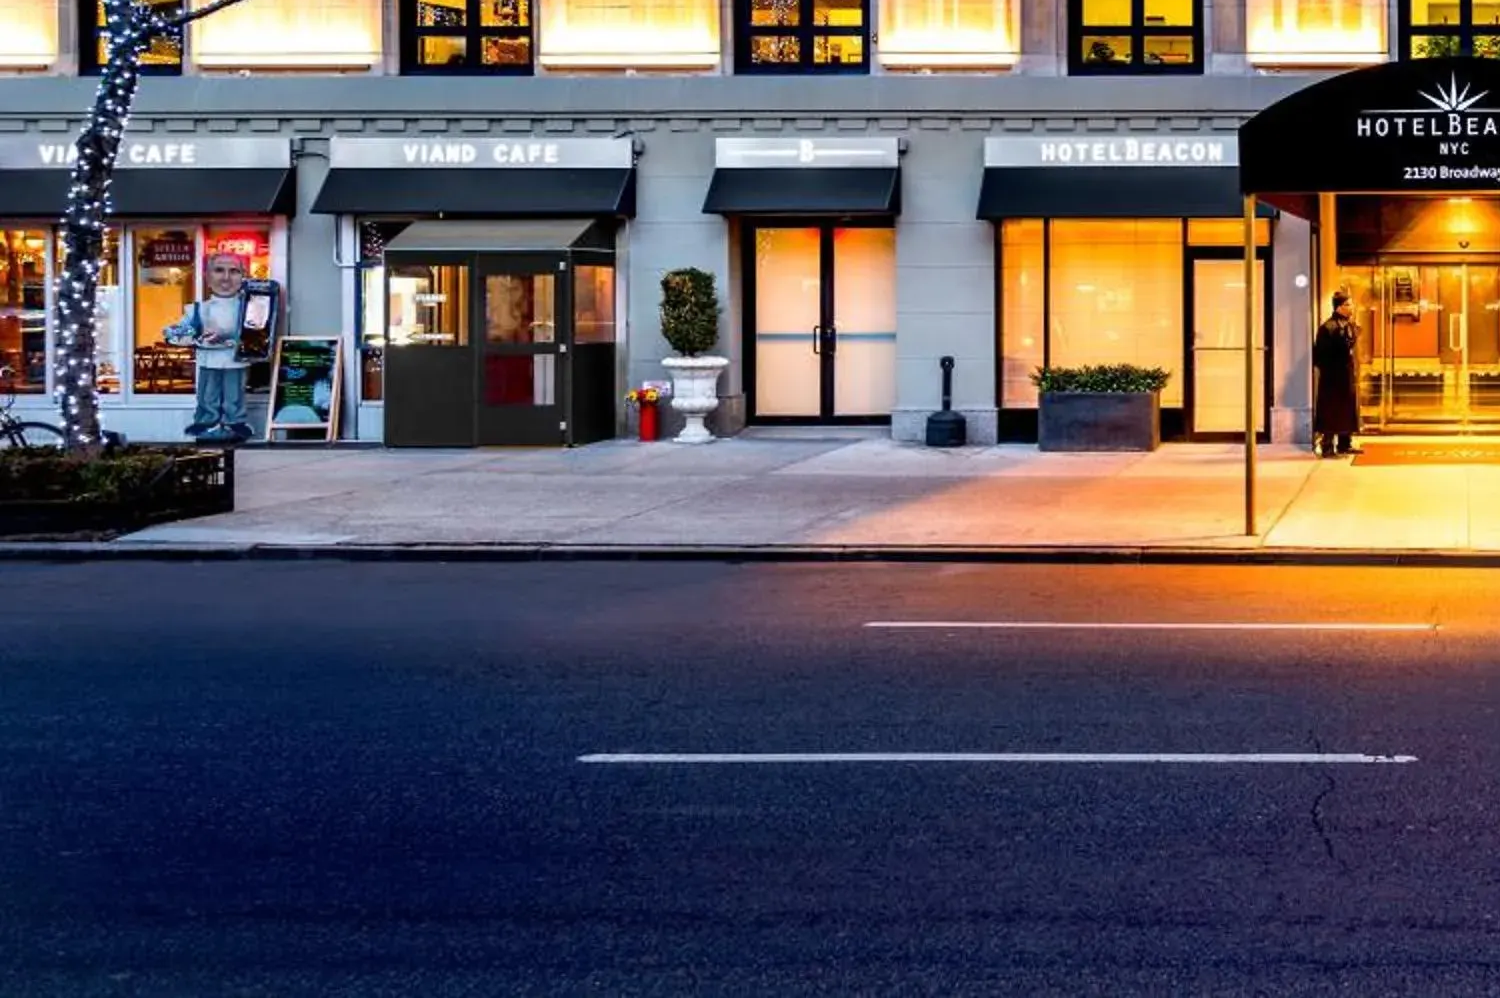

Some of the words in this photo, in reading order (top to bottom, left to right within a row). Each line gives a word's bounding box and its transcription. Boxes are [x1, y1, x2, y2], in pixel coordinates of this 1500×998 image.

[129, 144, 196, 163] CAFE
[403, 144, 476, 163] VIAND
[493, 144, 560, 163] CAFE
[799, 139, 816, 163] B
[1439, 142, 1470, 155] NYC
[1403, 167, 1437, 179] 2130
